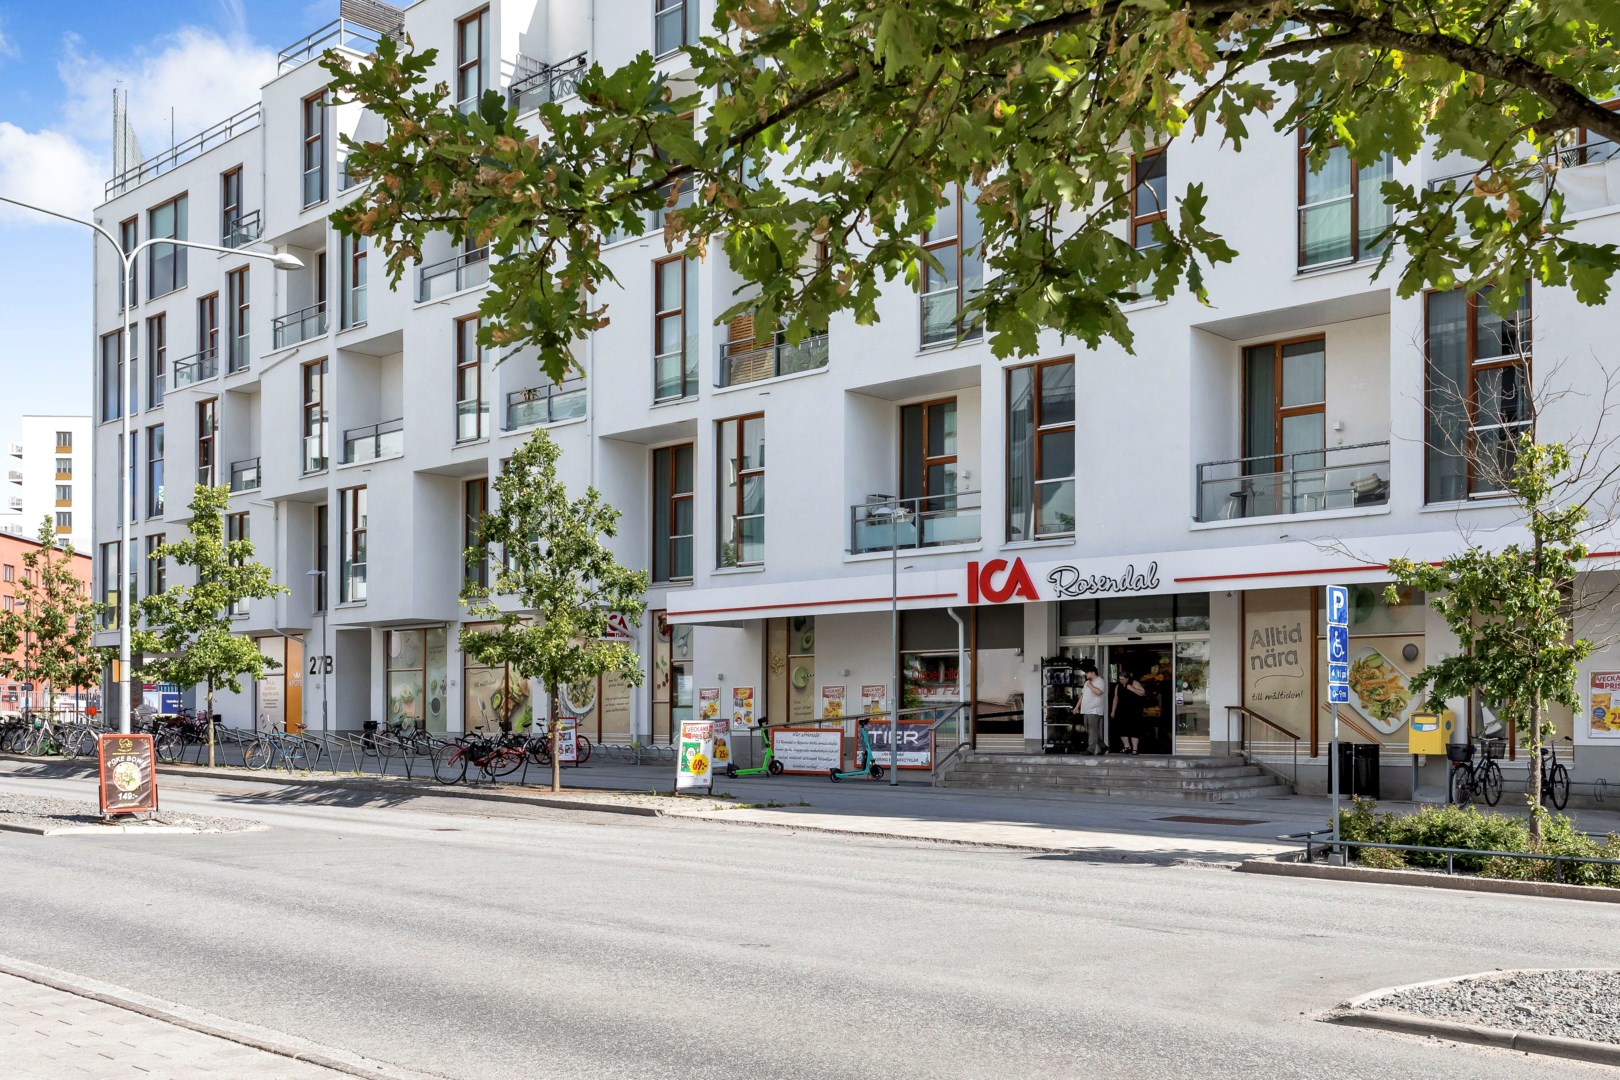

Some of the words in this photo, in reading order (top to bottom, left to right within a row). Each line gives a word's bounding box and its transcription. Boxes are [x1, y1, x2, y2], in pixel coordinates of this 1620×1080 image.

[967, 556, 1040, 604] ICA
[1047, 561, 1159, 597] Rosendal
[1333, 590, 1344, 620] P
[1250, 622, 1303, 649] Alltid
[309, 655, 334, 675] 27B
[1250, 648, 1298, 670] nära
[1252, 692, 1263, 701] till
[687, 725, 709, 733] VECKANS
[868, 730, 919, 745] TIER
[106, 756, 126, 768] POKE
[692, 759, 707, 771] 69:-
[118, 792, 139, 800] 149:-
